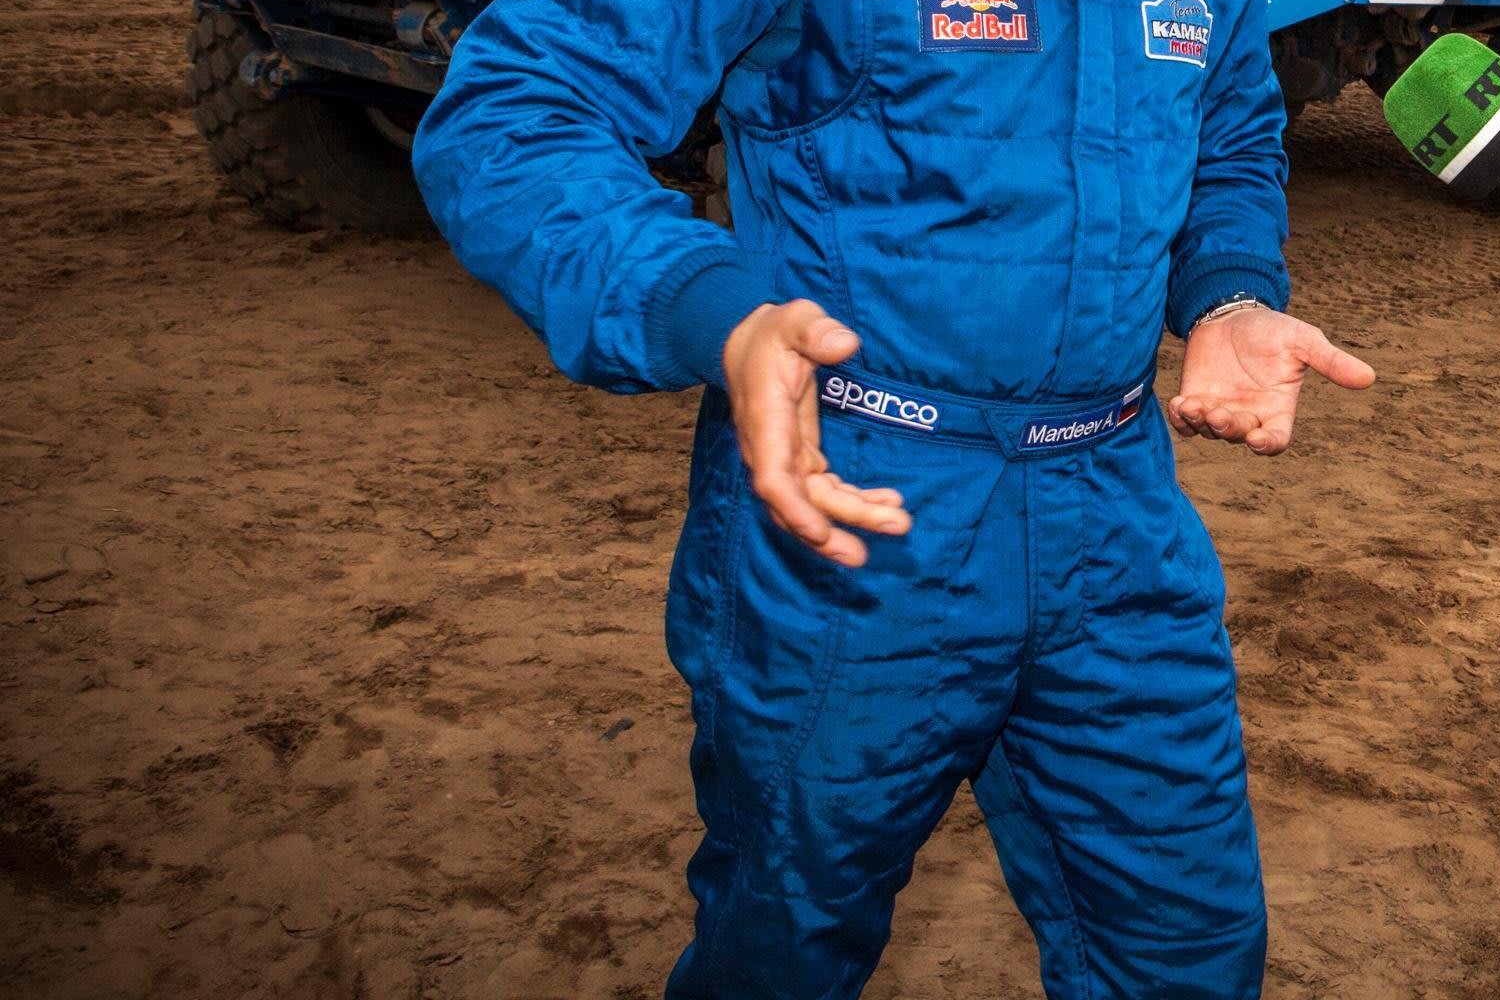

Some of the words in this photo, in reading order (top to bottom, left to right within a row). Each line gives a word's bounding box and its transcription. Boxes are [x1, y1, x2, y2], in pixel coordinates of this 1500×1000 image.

[932, 12, 983, 40] Red
[983, 13, 1028, 40] Bull
[1151, 20, 1209, 45] KAMAZ
[1412, 111, 1459, 168] RT
[821, 376, 938, 431] sparco
[1027, 420, 1100, 446] Mardeev
